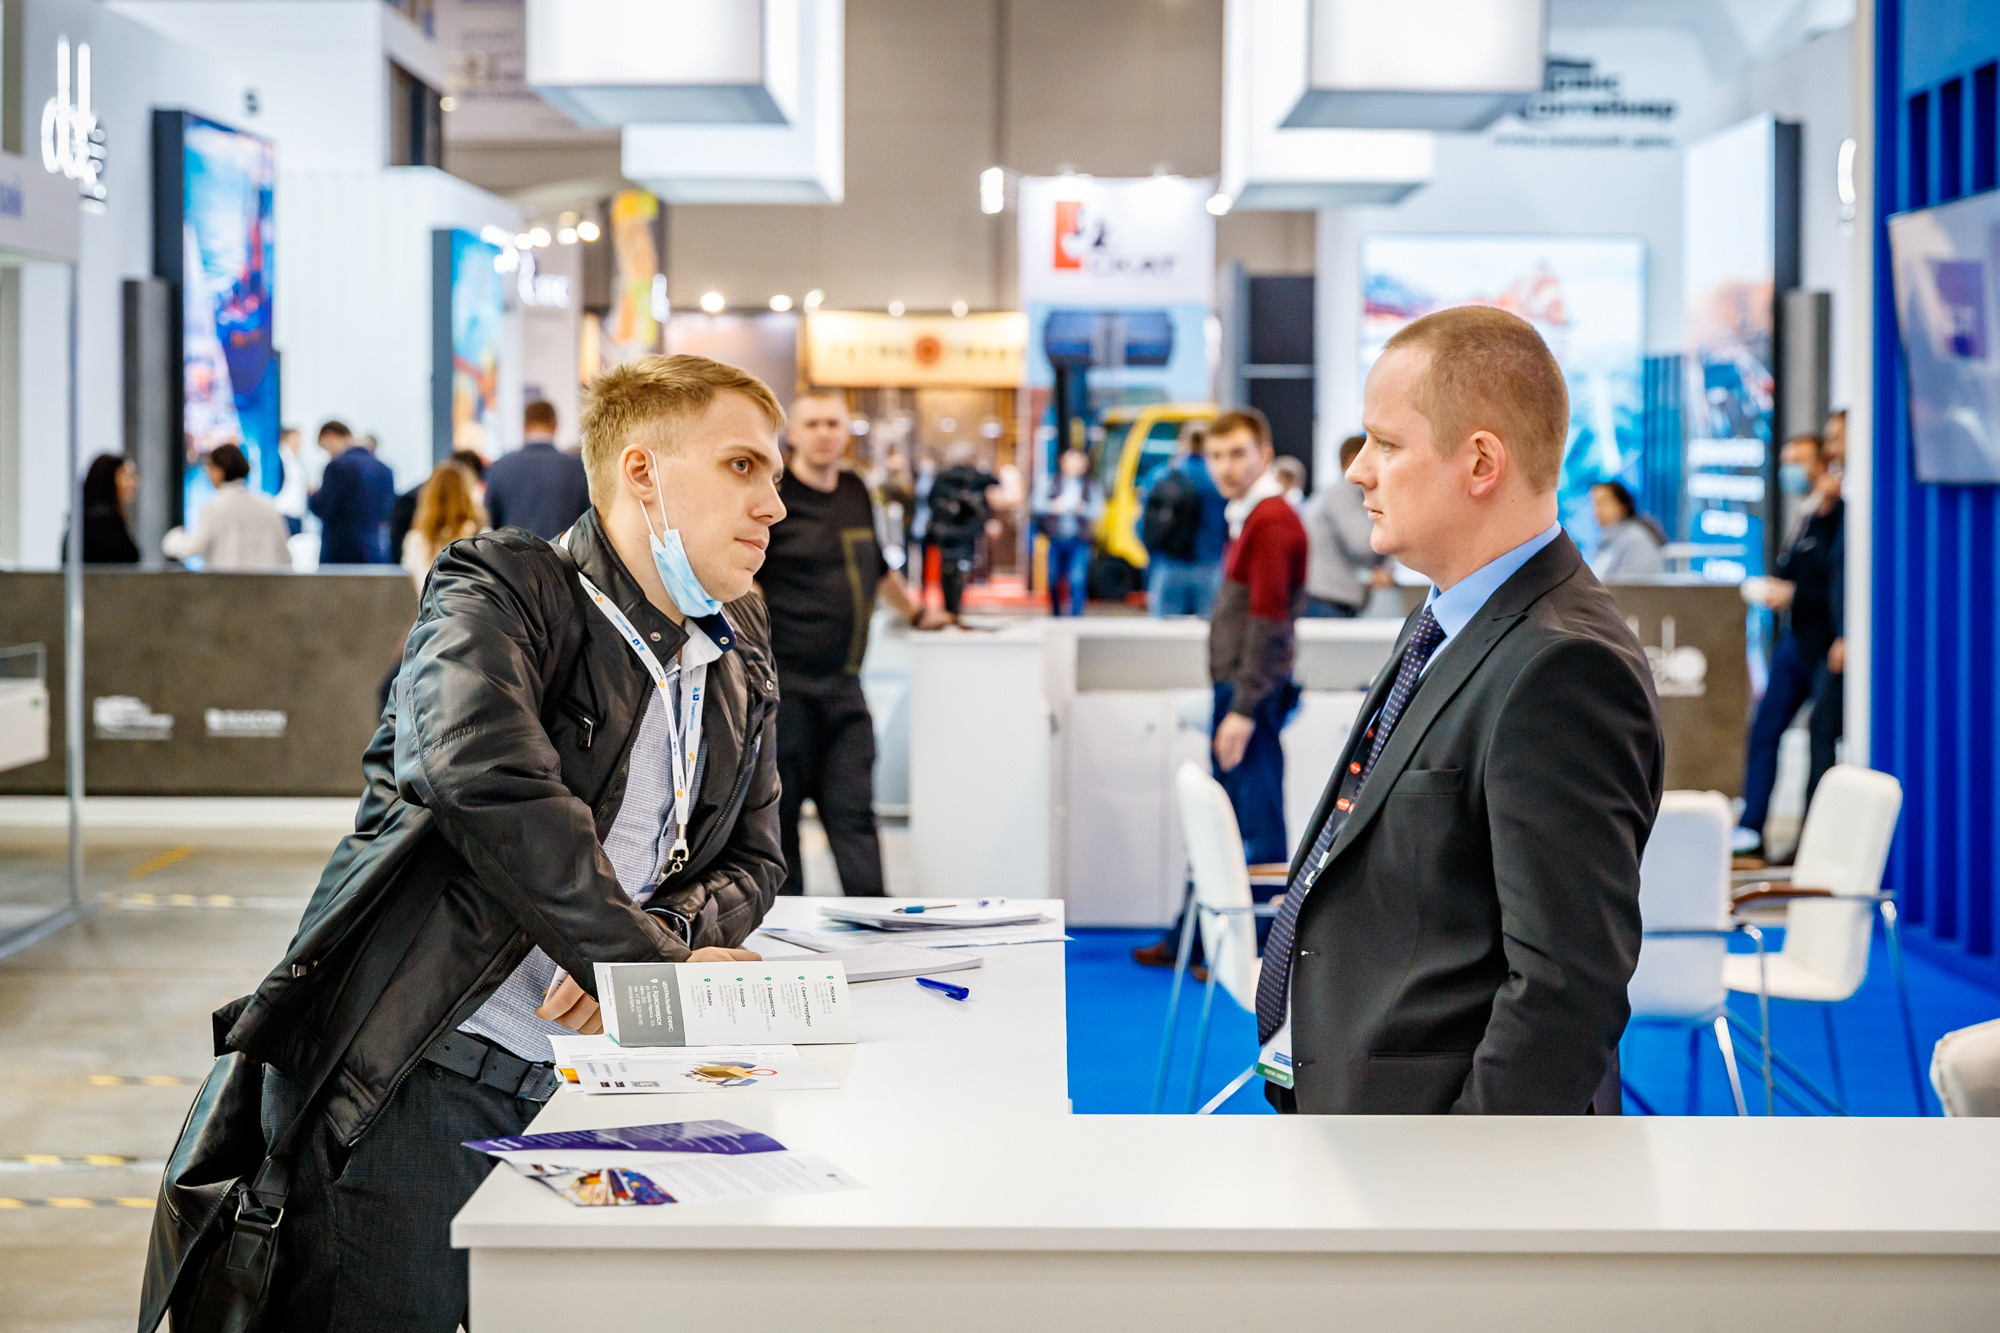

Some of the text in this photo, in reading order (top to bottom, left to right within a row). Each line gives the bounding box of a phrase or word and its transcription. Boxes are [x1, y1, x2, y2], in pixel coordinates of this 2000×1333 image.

[652, 991, 662, 1026] Красноярск
[662, 981, 672, 1015] ЦЕНТРАЛЬНЫЙ
[801, 986, 811, 1027] Санкт-Петербург
